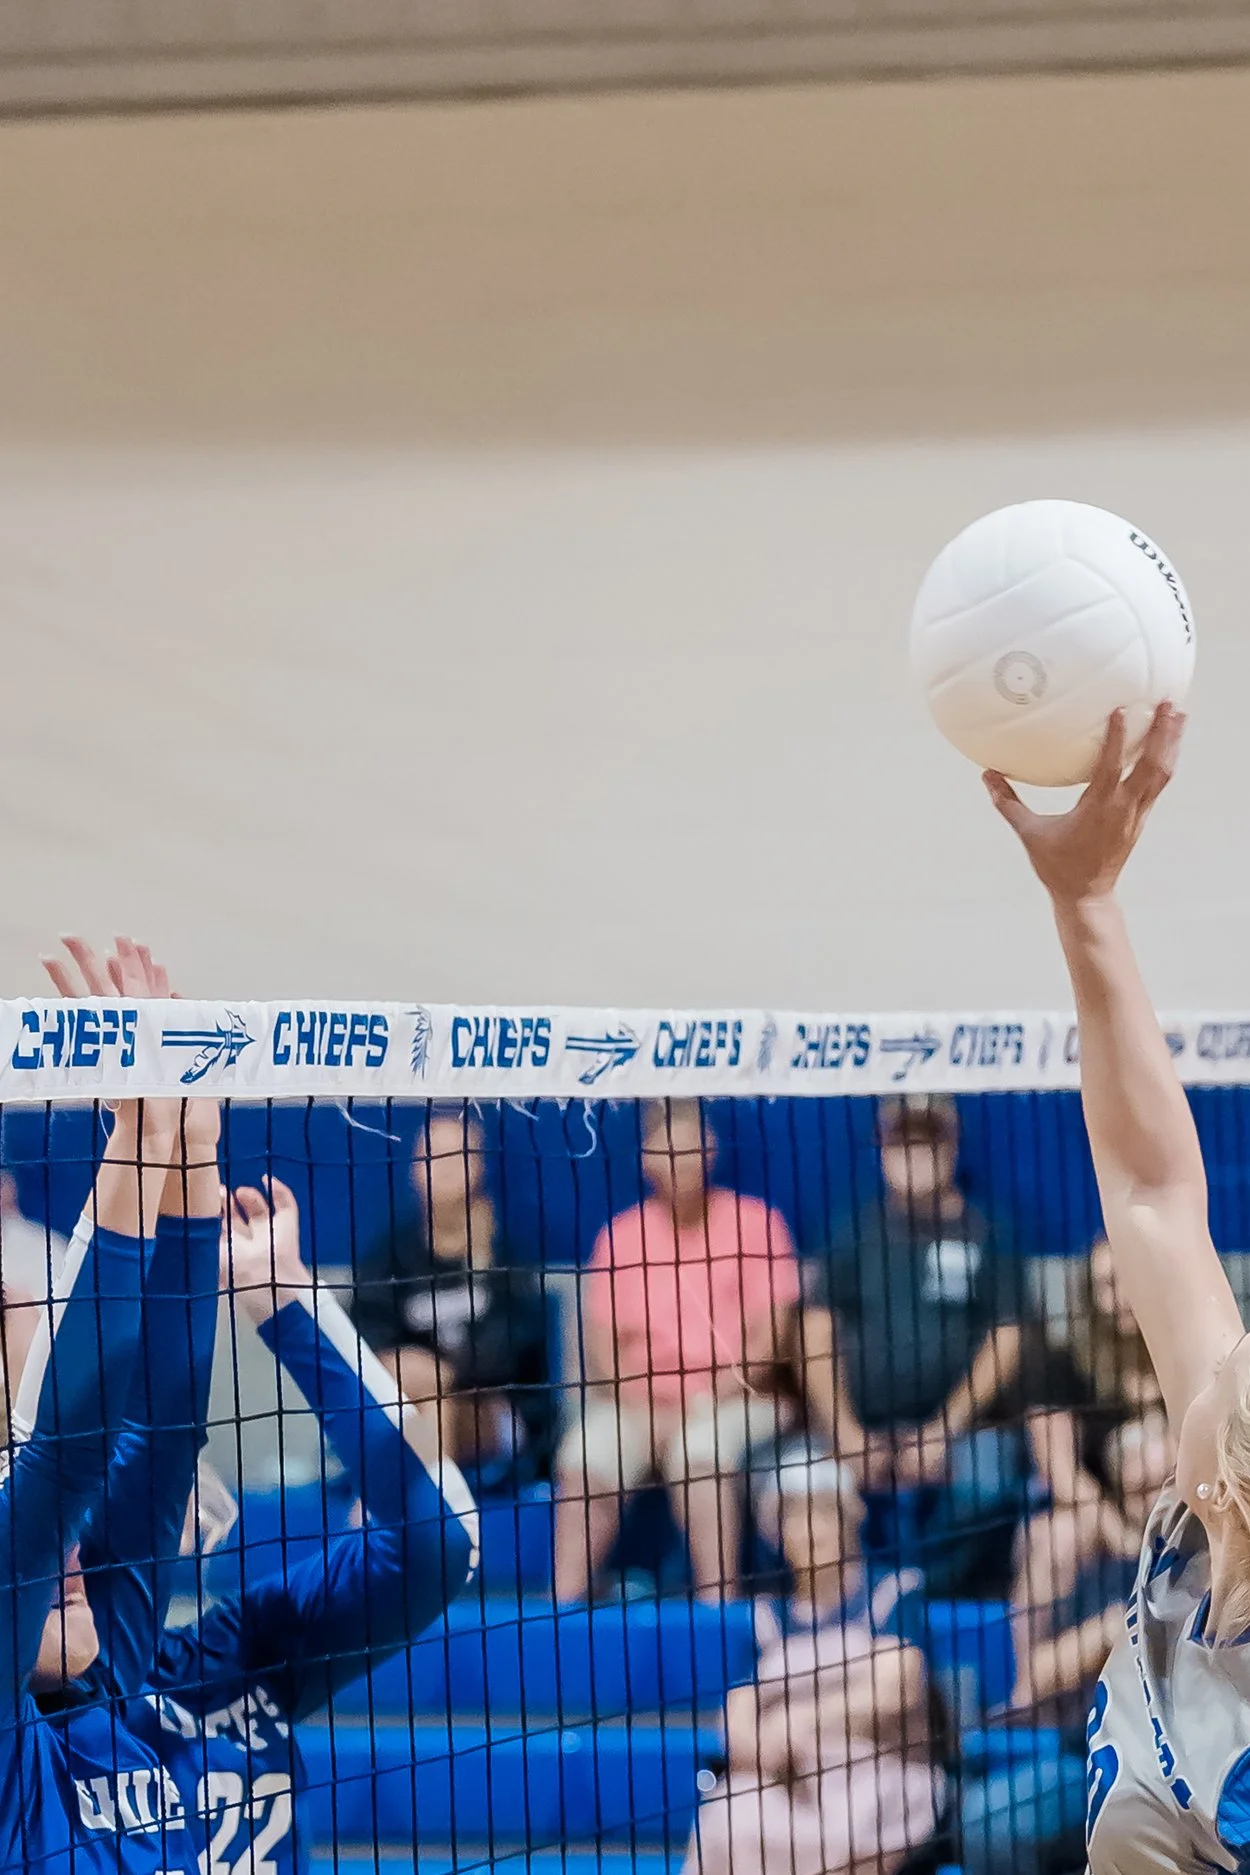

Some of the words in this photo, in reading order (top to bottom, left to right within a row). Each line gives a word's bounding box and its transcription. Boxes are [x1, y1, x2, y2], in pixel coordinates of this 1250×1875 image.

[11, 1008, 138, 1070] CHIEFS
[272, 1011, 390, 1069] CHIEFS
[450, 1015, 552, 1069] CHIEFS
[651, 1019, 743, 1069] CHIEFS
[790, 1023, 872, 1069] CHIEFS
